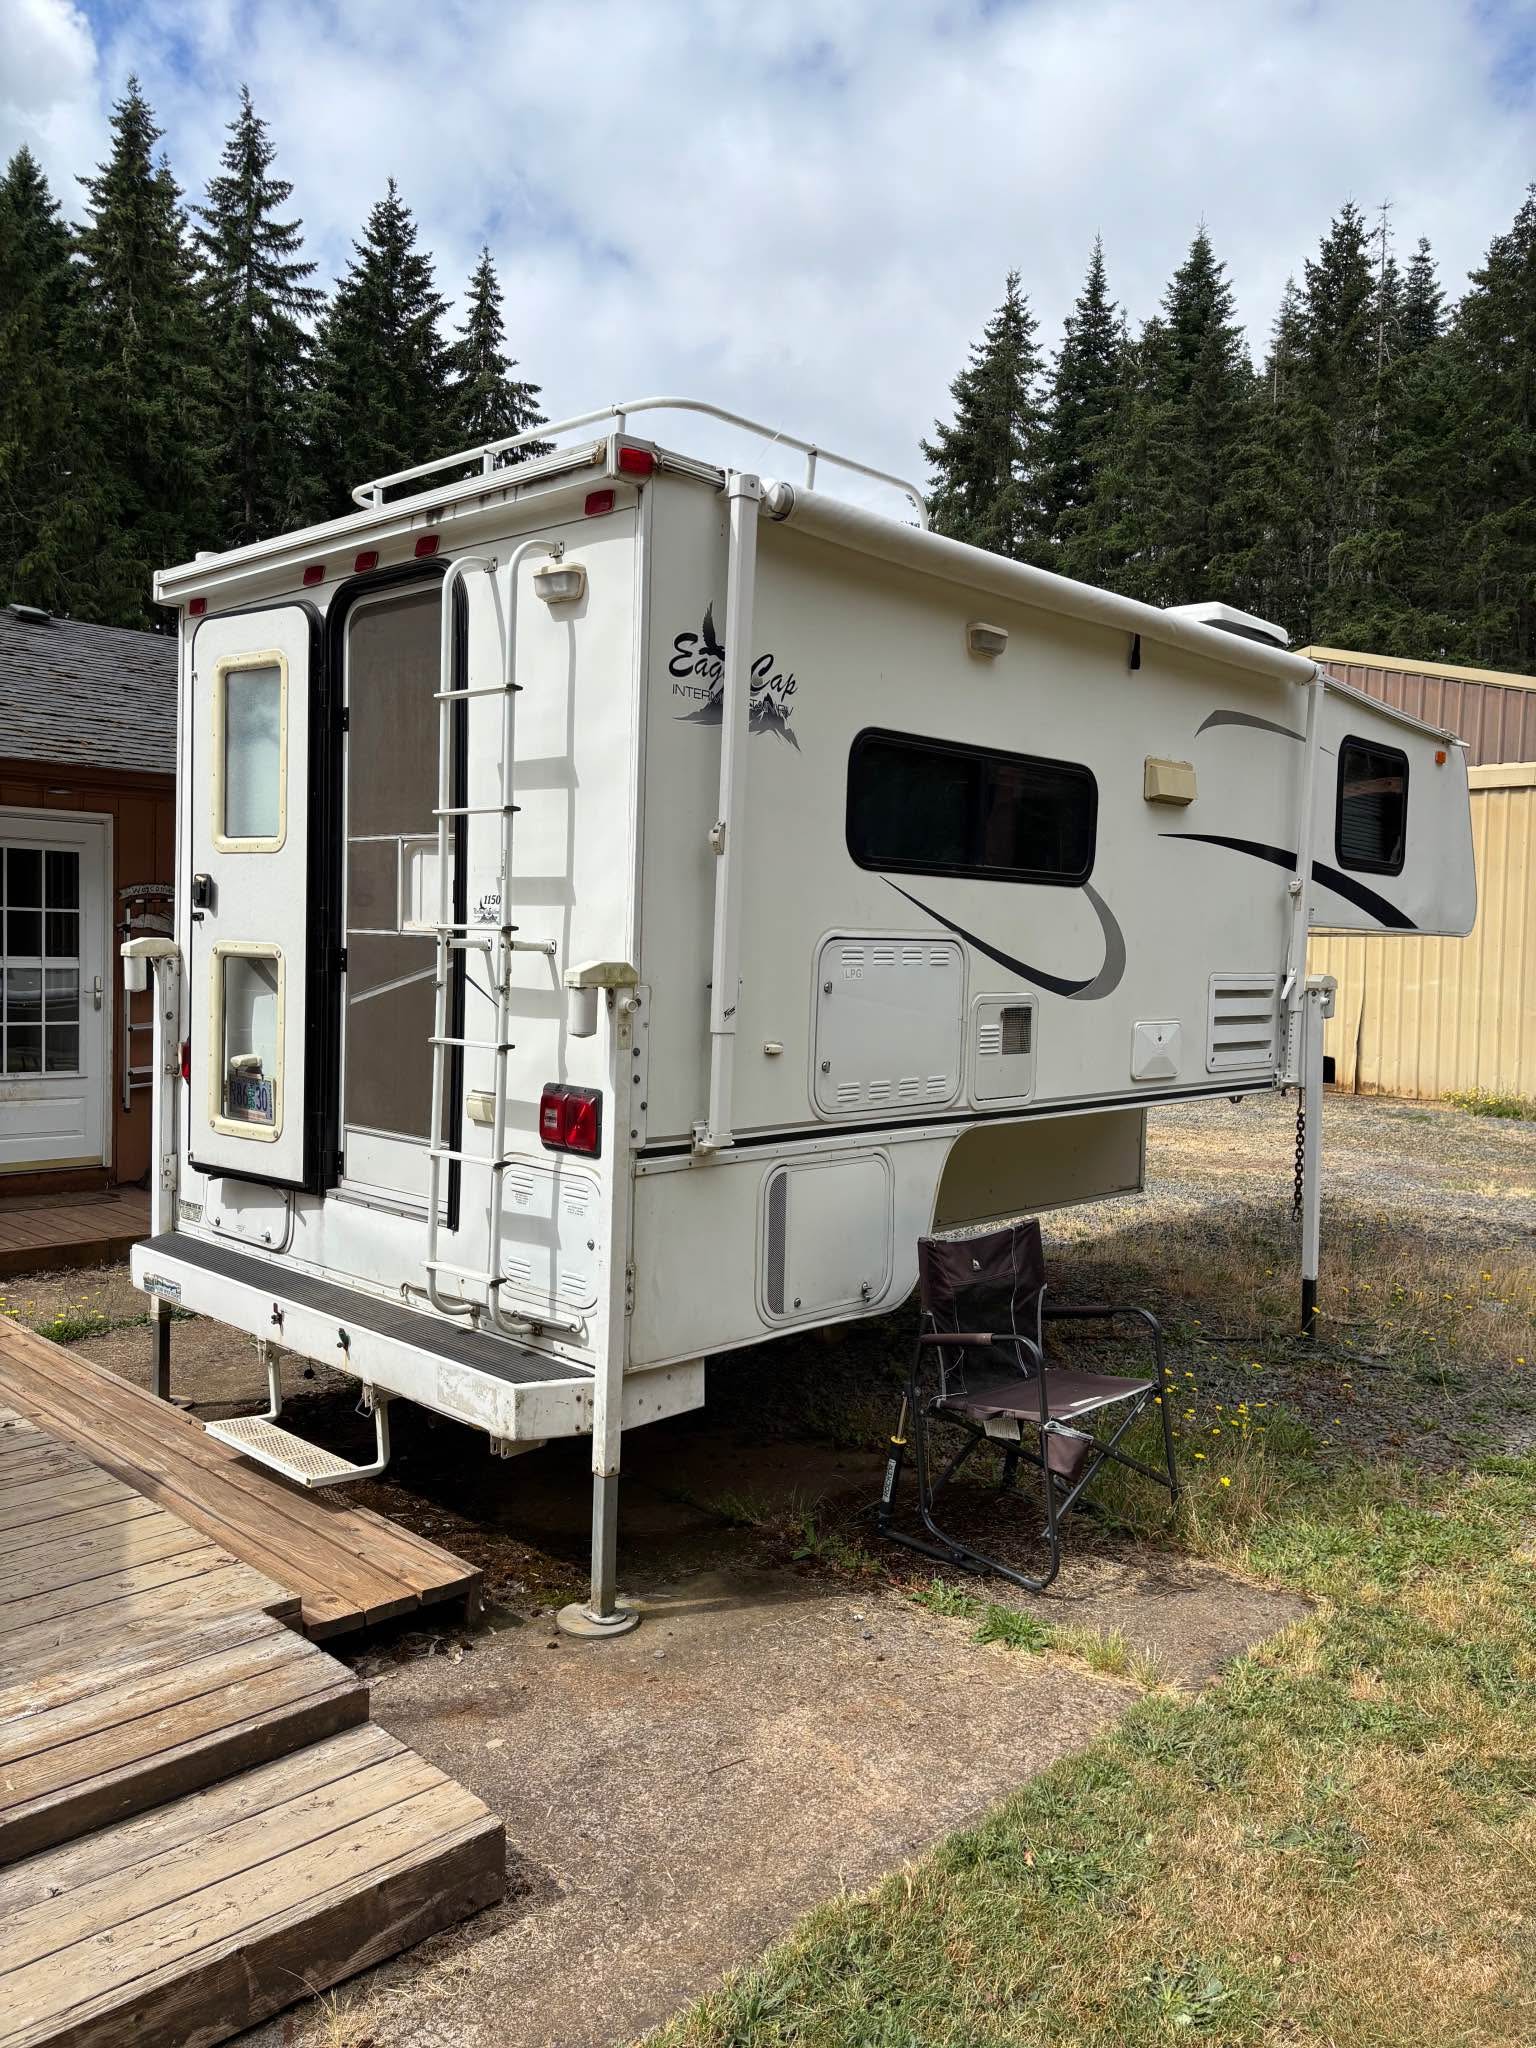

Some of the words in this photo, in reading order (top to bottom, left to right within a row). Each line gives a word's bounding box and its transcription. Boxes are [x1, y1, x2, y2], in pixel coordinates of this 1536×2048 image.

[750, 653, 798, 703] Cap
[484, 894, 502, 905] 1150
[844, 968, 862, 978] LPG
